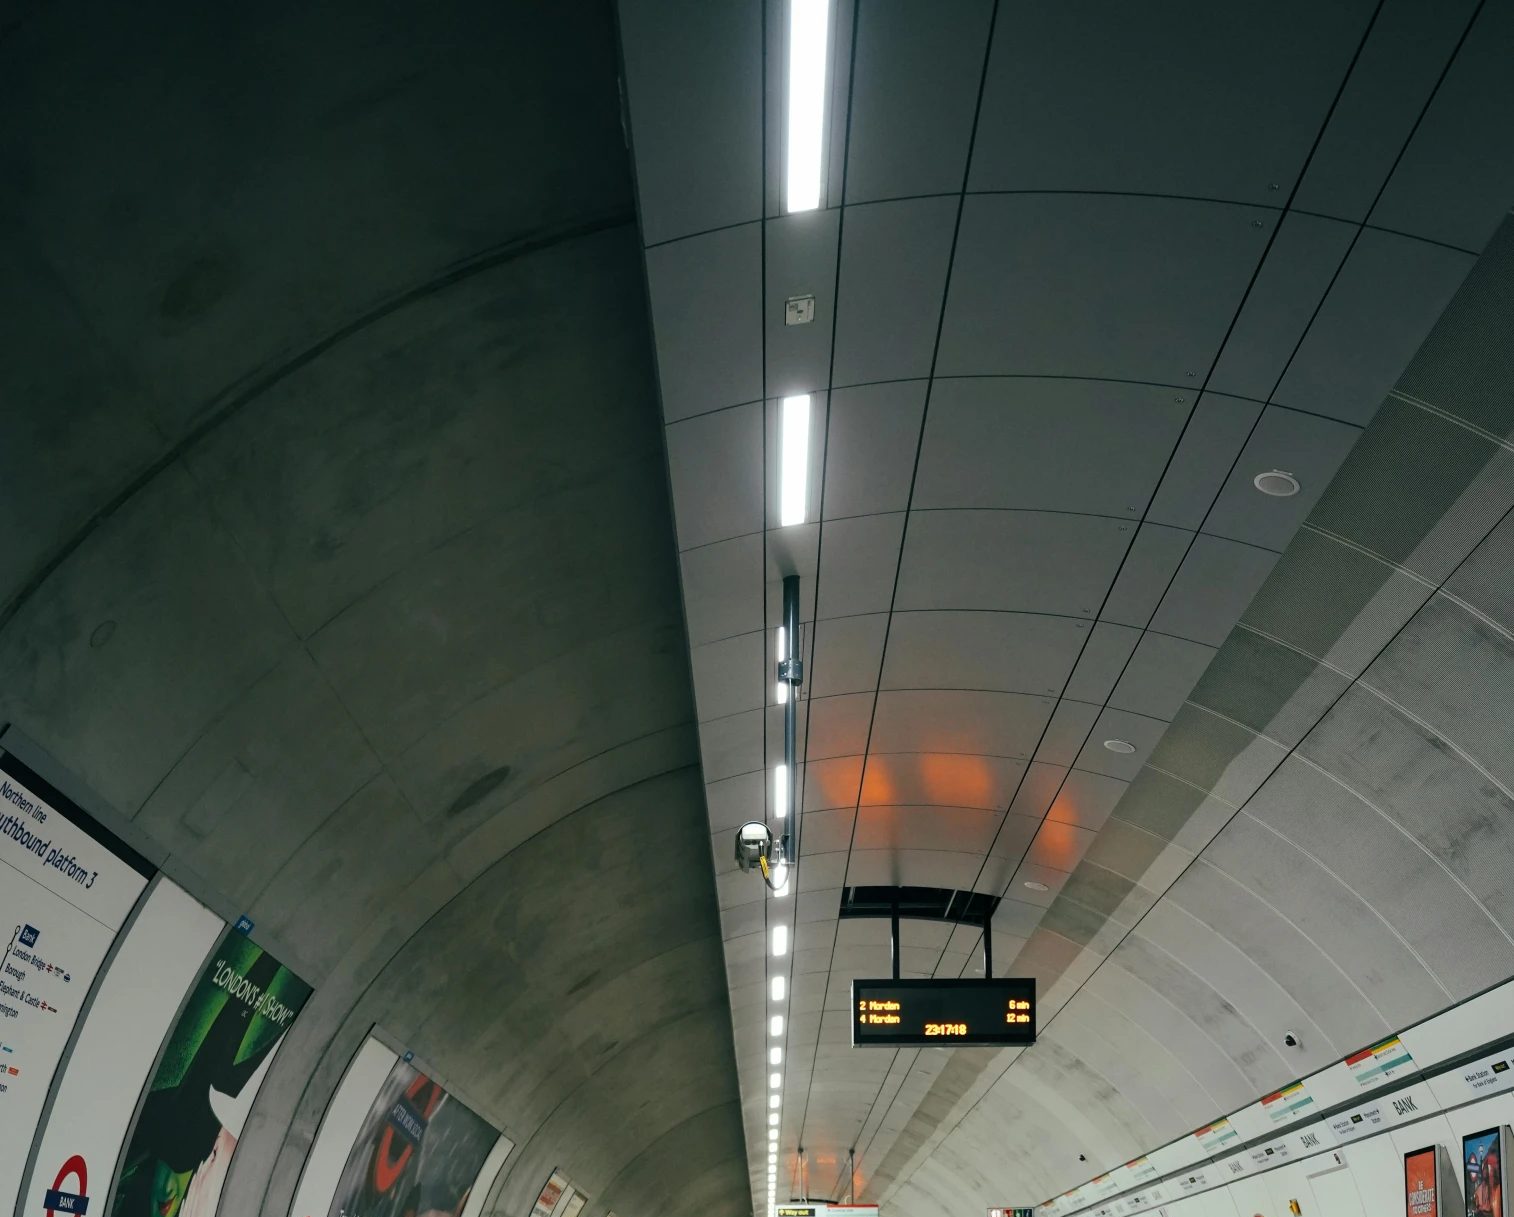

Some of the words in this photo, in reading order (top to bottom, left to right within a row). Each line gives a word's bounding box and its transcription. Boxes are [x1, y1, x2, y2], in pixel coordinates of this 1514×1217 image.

[0, 780, 34, 814] Northern
[32, 805, 47, 824] line
[0, 811, 52, 858] uthbound
[43, 848, 88, 885] platform
[86, 871, 98, 889] 3
[22, 928, 36, 944] Bank
[12, 945, 32, 964] London
[30, 955, 46, 971] Bridge
[4, 963, 26, 981] Borough
[19, 991, 25, 1001] &
[24, 993, 40, 1008] Castle
[859, 1001, 867, 1011] 2
[869, 1001, 900, 1011] Morden
[1008, 999, 1016, 1010] 6
[1016, 1000, 1030, 1010] min
[859, 1014, 867, 1024] 4
[869, 1014, 900, 1024] Morden
[1006, 1013, 1016, 1023] 12
[1016, 1013, 1030, 1023] min
[924, 1024, 967, 1036] 23:17:18
[1392, 1096, 1418, 1116] BANK
[1300, 1132, 1320, 1148] BANK
[1418, 1180, 1424, 1190] BE
[59, 1196, 75, 1209] BANK
[1409, 1188, 1435, 1206] CONSIDERATE
